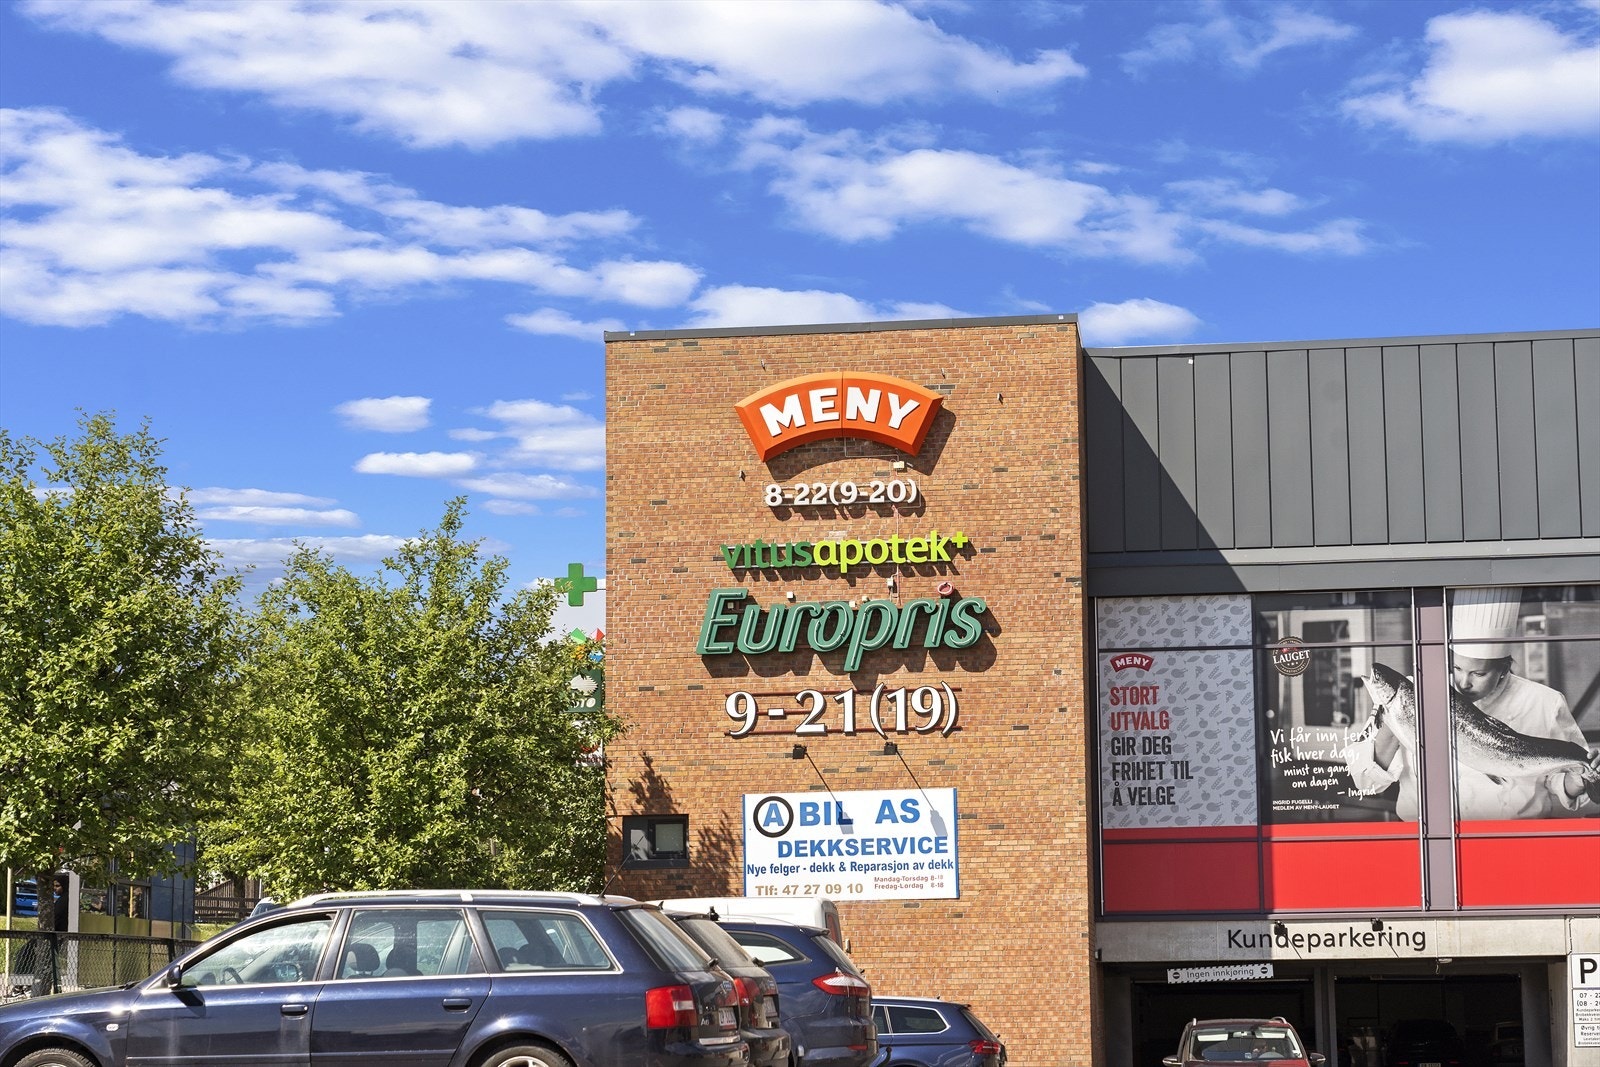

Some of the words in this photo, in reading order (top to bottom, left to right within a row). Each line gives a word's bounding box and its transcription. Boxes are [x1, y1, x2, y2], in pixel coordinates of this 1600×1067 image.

[759, 387, 920, 437] MENY
[765, 479, 918, 507] 8-22(9-20)
[696, 587, 987, 672] Europris
[1115, 656, 1149, 668] MENY
[1273, 650, 1310, 664] LAUGET
[1110, 686, 1160, 706] STORT
[1110, 710, 1170, 731] UTVALG
[1111, 736, 1136, 756] GIR
[1142, 736, 1172, 756] DEG
[1270, 729, 1285, 745] Vi
[1289, 726, 1311, 749] får
[1316, 728, 1338, 742] inn
[1270, 747, 1292, 769] fisk
[1296, 746, 1325, 761] hver
[1112, 761, 1166, 781] FRIHET
[1170, 760, 1194, 780] TIL
[1283, 763, 1310, 777] minst
[1327, 765, 1352, 778] gang
[1112, 781, 1123, 806] Å
[1127, 786, 1176, 806] VELGE
[1291, 780, 1308, 789] om
[1310, 776, 1339, 791] dagen
[1348, 787, 1377, 801] Ingrid
[799, 800, 854, 827] BIL
[875, 798, 921, 825] AS
[778, 836, 949, 859] DEKKSERVICE
[747, 863, 767, 876] Nye
[770, 863, 801, 877] felger
[809, 861, 835, 873] dekk
[838, 861, 847, 872] &
[850, 859, 910, 874] Reparasjon
[912, 861, 925, 871] av
[928, 859, 954, 870] dekk
[755, 885, 778, 896] Tlf:
[782, 884, 799, 896] 47
[804, 884, 821, 895] 27
[825, 884, 842, 894] 09
[847, 883, 864, 894] 10
[1228, 927, 1426, 953] Kundeparkering
[1186, 971, 1210, 979] Ingen
[1212, 968, 1254, 977] innkjøring
[1579, 958, 1598, 985] P
